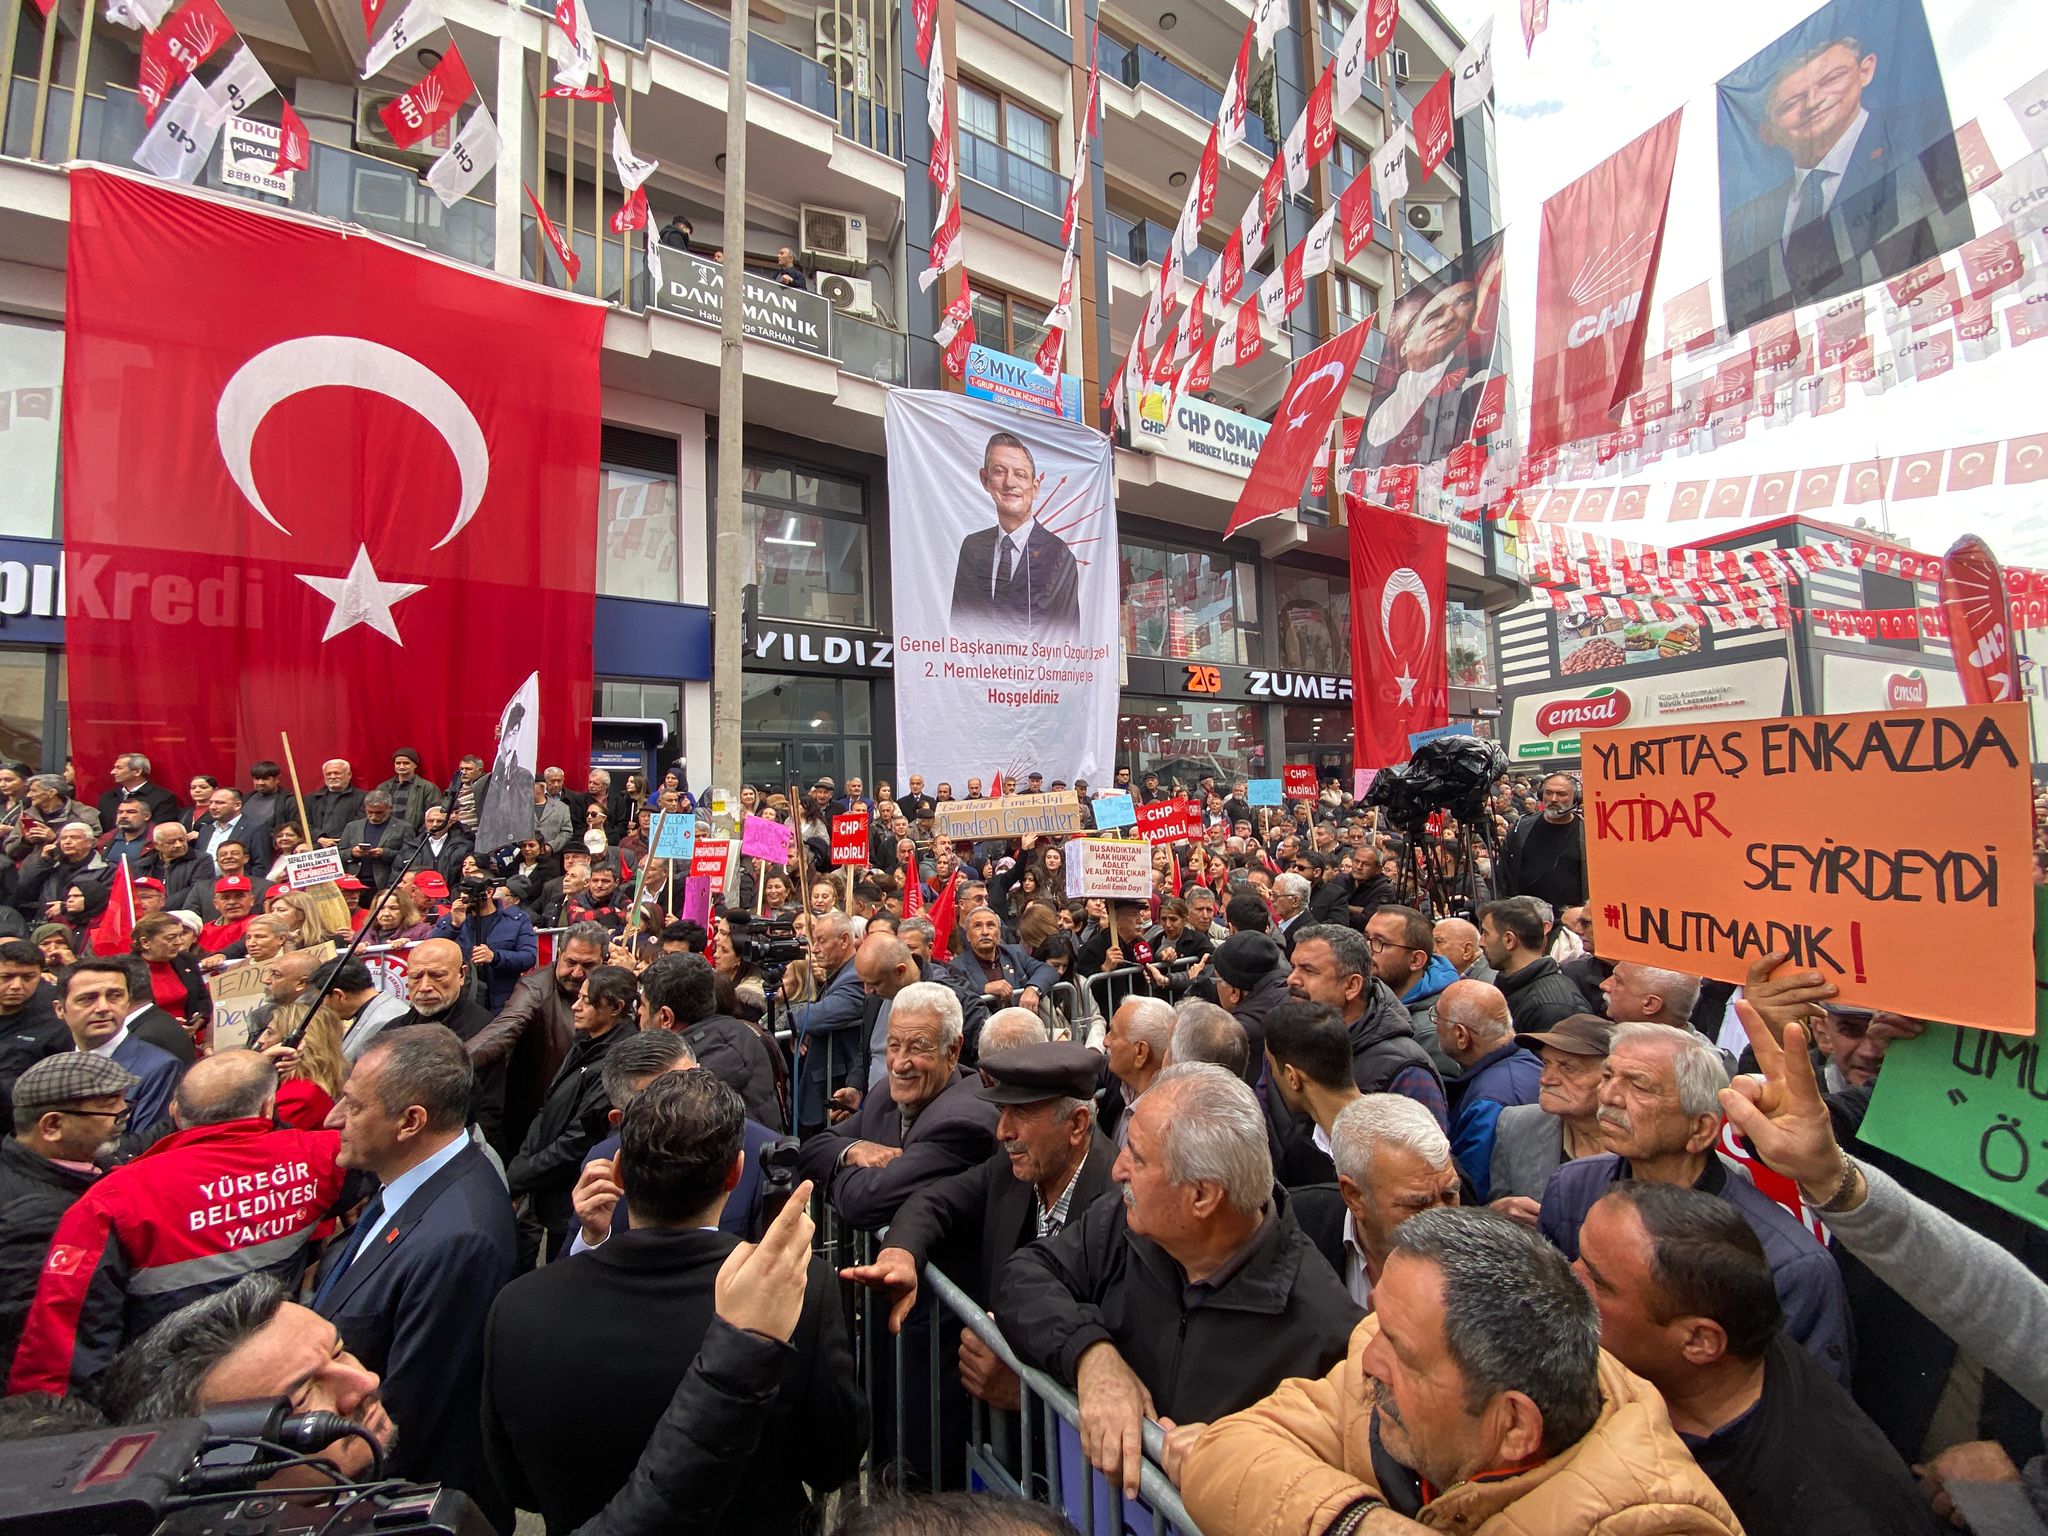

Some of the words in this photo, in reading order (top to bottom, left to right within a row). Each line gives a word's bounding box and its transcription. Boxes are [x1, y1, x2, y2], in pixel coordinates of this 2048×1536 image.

[231, 119, 282, 140] TOKU
[1313, 124, 1332, 149] CH
[1426, 131, 1448, 168] CHP
[1349, 224, 1370, 251] CHP
[691, 261, 797, 313] TAHAN
[1225, 270, 1240, 292] CHP
[1897, 273, 1930, 299] CHP
[1267, 287, 1284, 307] HP
[1286, 287, 1302, 304] HP
[670, 281, 818, 338] DANMANLIK
[700, 309, 722, 323] Hatu
[758, 327, 795, 344] TARHAN
[1240, 340, 1260, 359] CHP
[1758, 343, 1791, 364] CHP
[1899, 341, 1928, 357] CHP
[990, 359, 1027, 387] MYK
[1800, 377, 1824, 392] CHP
[1477, 413, 1497, 428] CHP
[1634, 402, 1665, 420] CHP
[1141, 419, 1166, 434] CHP
[1178, 408, 1211, 436] CHP
[1215, 418, 1266, 453] OSMAN
[1188, 439, 1221, 460] MERKEZ
[1223, 450, 1239, 465] İLÇE
[1381, 477, 1400, 488] CHP
[1449, 467, 1467, 479] CHP
[756, 631, 893, 668] YILDIZ
[900, 636, 945, 653] Genel
[950, 637, 1028, 657] Başkanımız
[1031, 642, 1061, 660] Sayın
[924, 662, 939, 678] 2.
[943, 662, 1035, 681] Memleketiniz
[988, 688, 1059, 705] Hoşgeldiniz
[1893, 684, 1922, 702] emsal
[1549, 698, 1616, 725] emsal
[1593, 731, 1748, 779] YURTTAŞ
[1761, 717, 2020, 775] ENKAZDA
[1290, 769, 1307, 779] CHP
[1287, 784, 1316, 796] KADİRLİ
[942, 802, 992, 812] Gariban
[1002, 794, 1063, 808] Emekliyi
[1147, 805, 1173, 821] CHP
[1595, 790, 1733, 842] İKTİDAR
[840, 821, 859, 835] CHP
[1142, 820, 1187, 841] KADİRLİ
[288, 855, 306, 864] SEFALET
[833, 842, 866, 859] KADİRLİ
[1101, 845, 1141, 854] SANDIKTAN
[297, 859, 330, 868] BİRLİKTE
[1103, 861, 1129, 869] ADALET
[1744, 837, 1999, 907] SEYİRDEYDİ
[200, 1161, 309, 1200] YÜREĞİR
[189, 1179, 318, 1231] BELEDİYESİ
[225, 1214, 296, 1247] YAKUT
